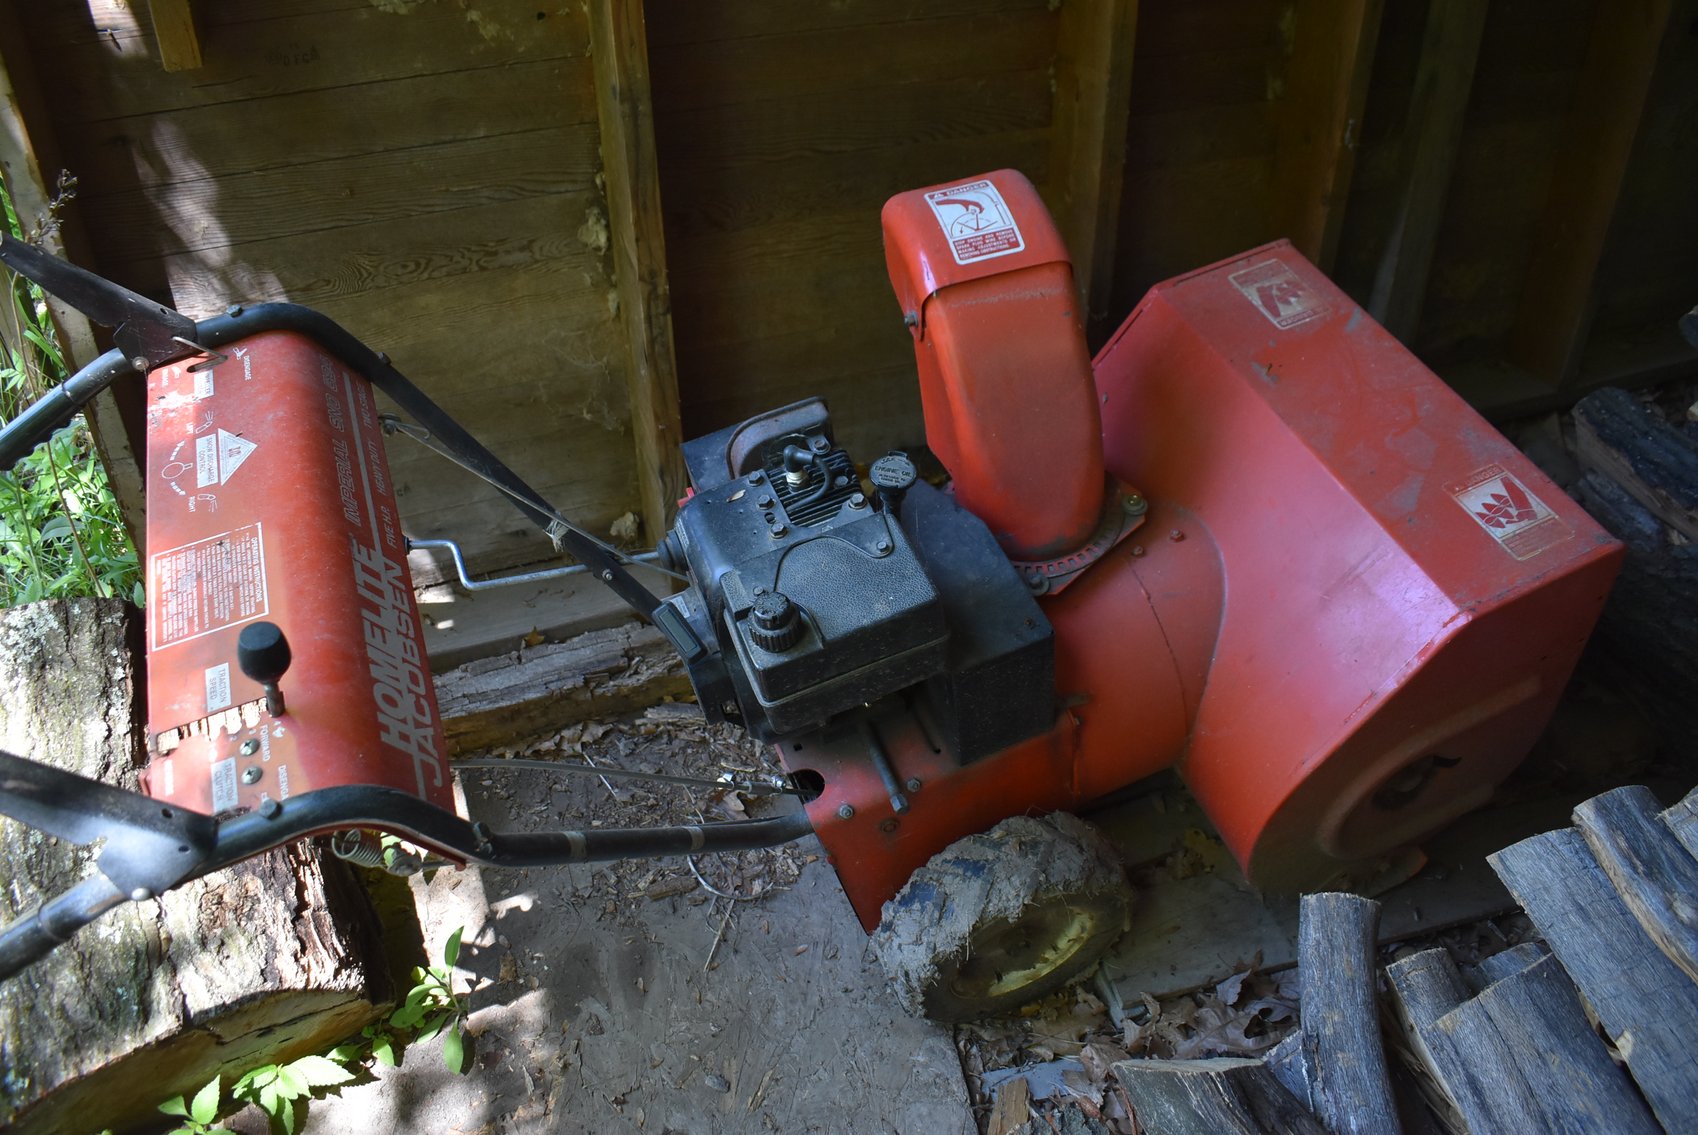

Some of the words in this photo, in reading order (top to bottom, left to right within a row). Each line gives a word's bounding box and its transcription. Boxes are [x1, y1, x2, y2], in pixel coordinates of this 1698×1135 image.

[946, 183, 987, 196] DANGER
[243, 355, 252, 381] DISENGAGE
[198, 449, 206, 475] CONTROL
[368, 440, 380, 464] DUTY
[207, 453, 216, 483] DISCHARGE
[334, 440, 361, 526] IMPERIAL
[373, 466, 387, 496] HEAVY
[874, 466, 900, 474] ENGINE
[187, 495, 195, 513] RIGHT
[384, 525, 397, 550] FIVE
[353, 540, 414, 755] HOMELITE
[219, 668, 227, 703] TRACTION
[380, 555, 443, 787] JACOBSEN
[209, 678, 217, 700] SPEED
[260, 724, 271, 762] FORWARD
[223, 763, 234, 801] TRACTION
[278, 764, 289, 801] DISENGA
